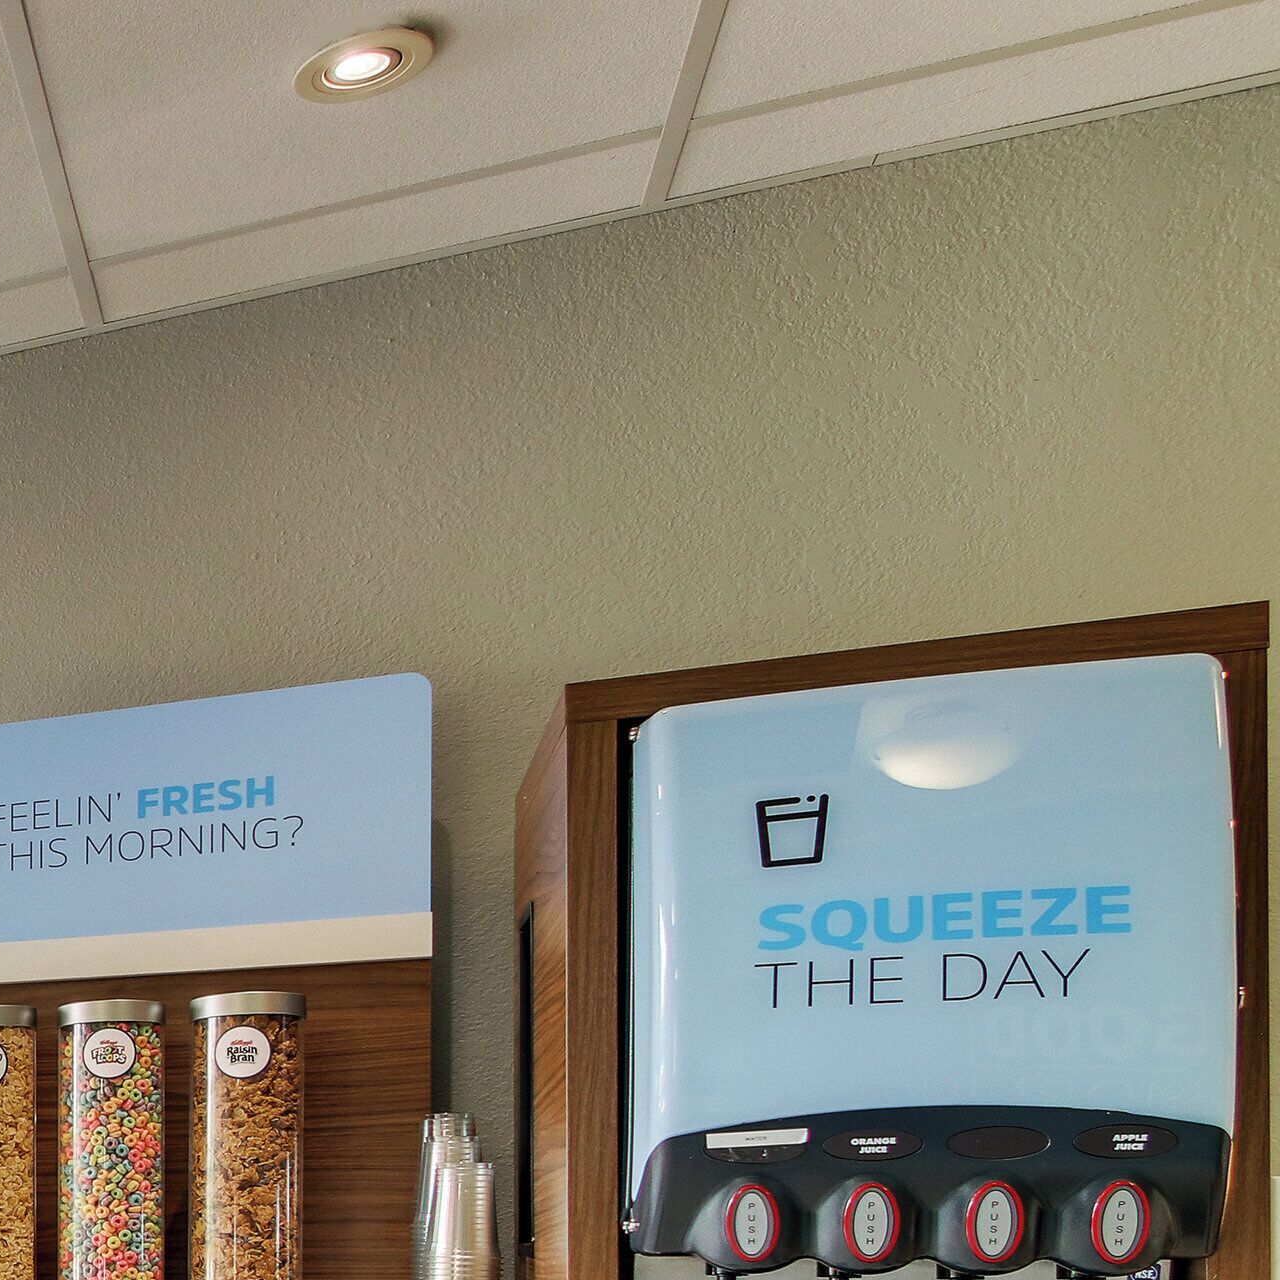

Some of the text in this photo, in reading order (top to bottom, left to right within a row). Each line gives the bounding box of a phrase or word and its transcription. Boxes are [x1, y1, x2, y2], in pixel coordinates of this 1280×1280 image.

[137, 775, 276, 819] FRESH
[84, 814, 305, 866] MORNING?
[755, 884, 1133, 952] SQUEEZE
[754, 948, 1092, 1009] THE DAY
[96, 1053, 127, 1064] LOOPS
[226, 1046, 259, 1057] Raisin
[230, 1054, 255, 1064] Bran
[850, 1136, 898, 1146] ORANGE
[858, 1145, 889, 1155] JUICE
[1112, 1133, 1149, 1143] APPLE
[1113, 1142, 1145, 1152] JUICE
[748, 1202, 756, 1246] PUSH
[866, 1201, 876, 1246] PUSH
[988, 1200, 1000, 1246] PUSH
[1114, 1200, 1126, 1247] PUSH
